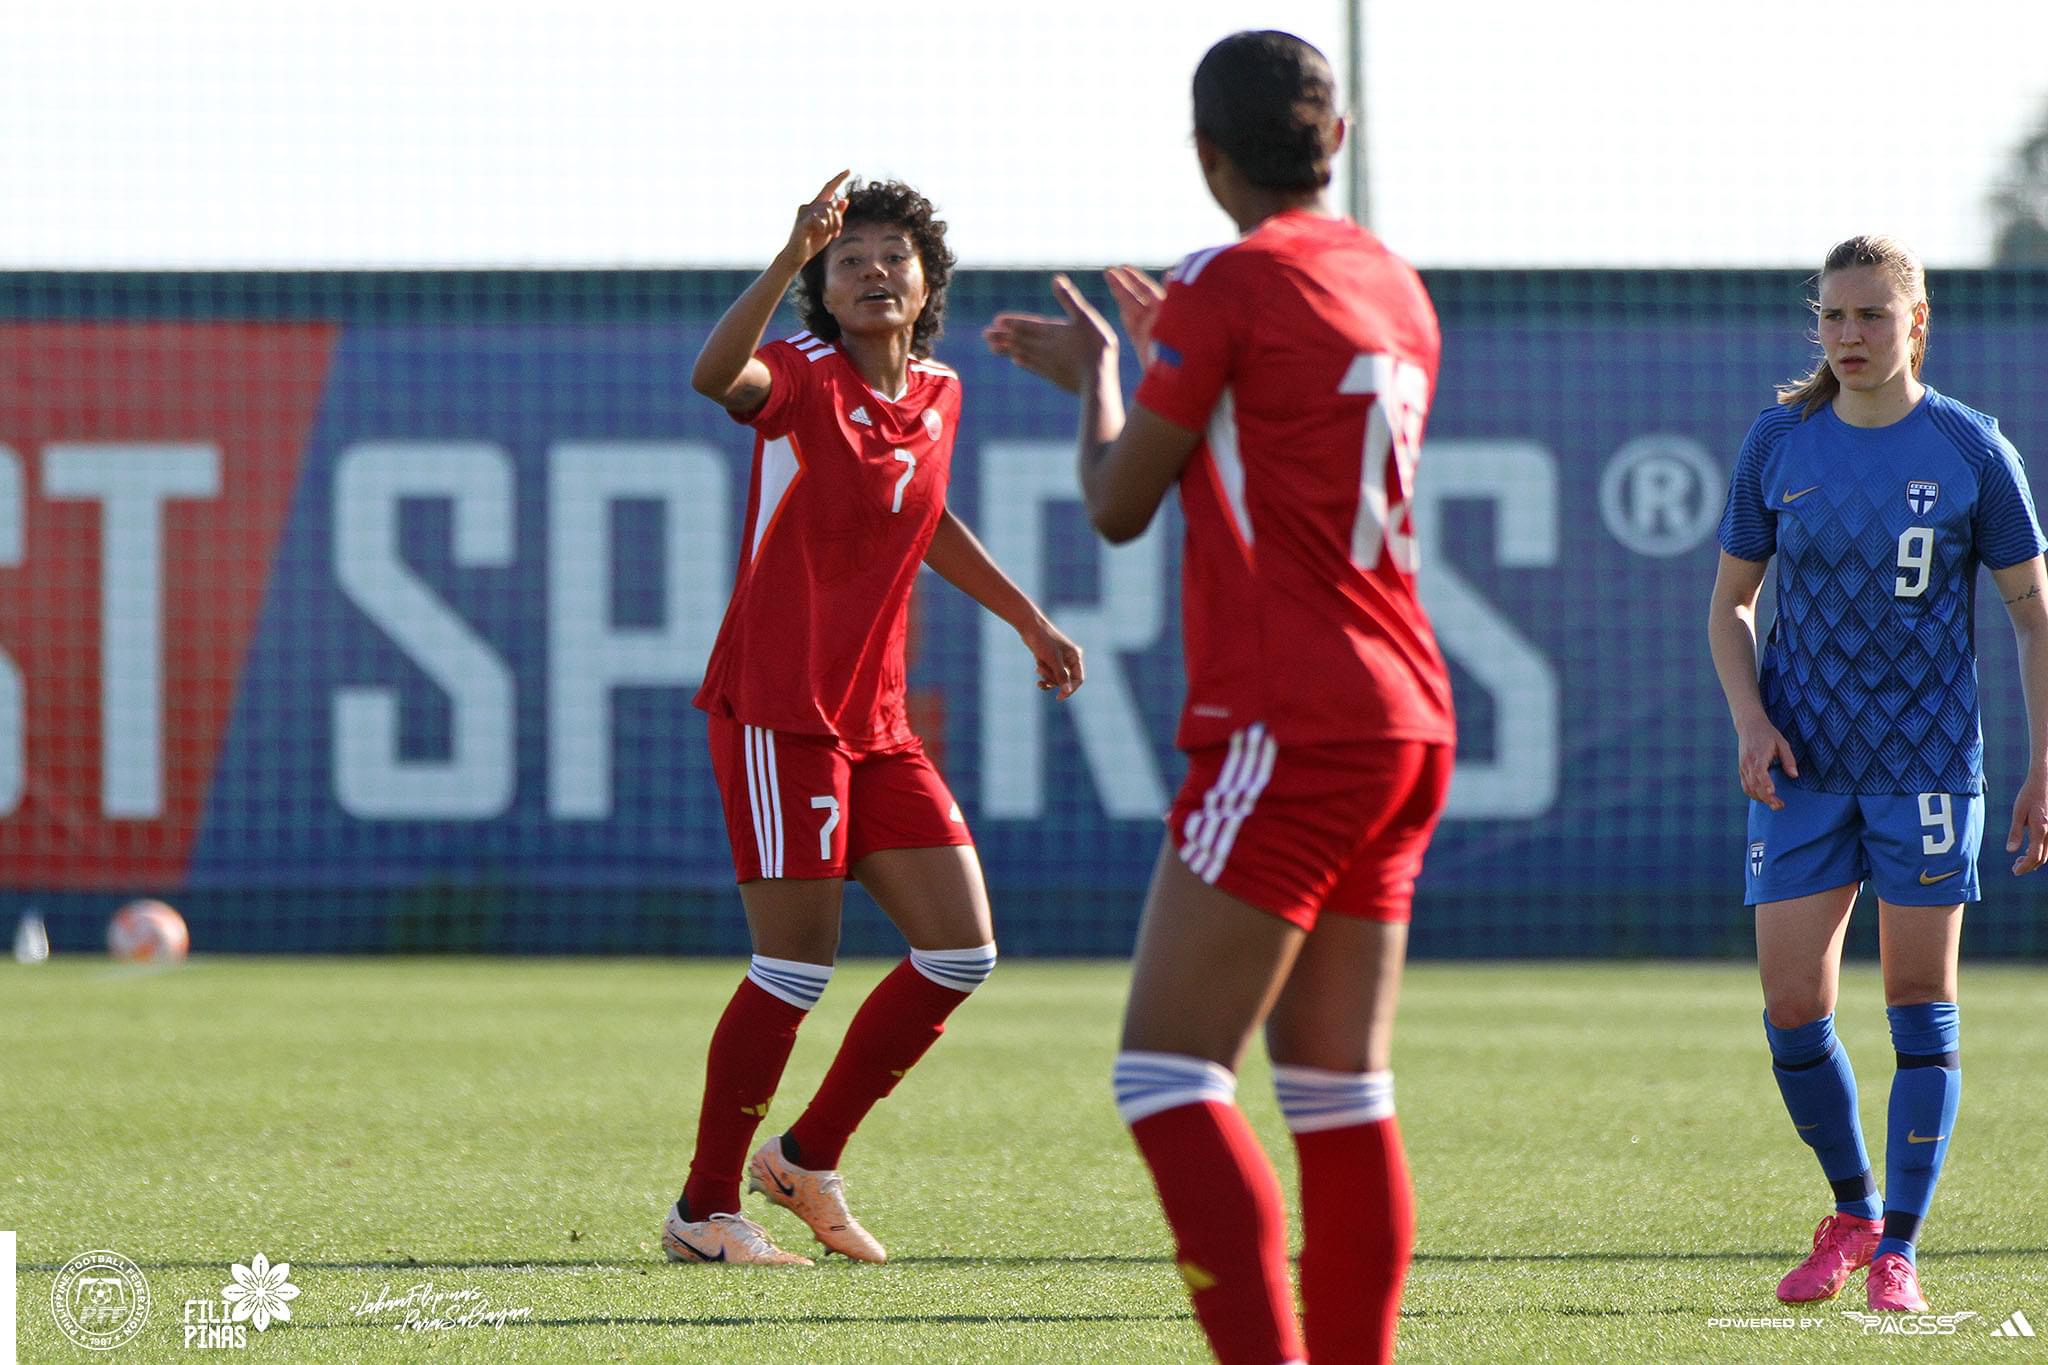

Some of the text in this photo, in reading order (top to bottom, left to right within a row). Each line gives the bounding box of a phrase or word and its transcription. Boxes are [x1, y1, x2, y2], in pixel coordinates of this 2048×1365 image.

[891, 448, 917, 514] 7
[1895, 526, 1935, 597] 9
[0, 442, 222, 820] T
[810, 795, 840, 861] 7
[1917, 792, 1956, 855] 9
